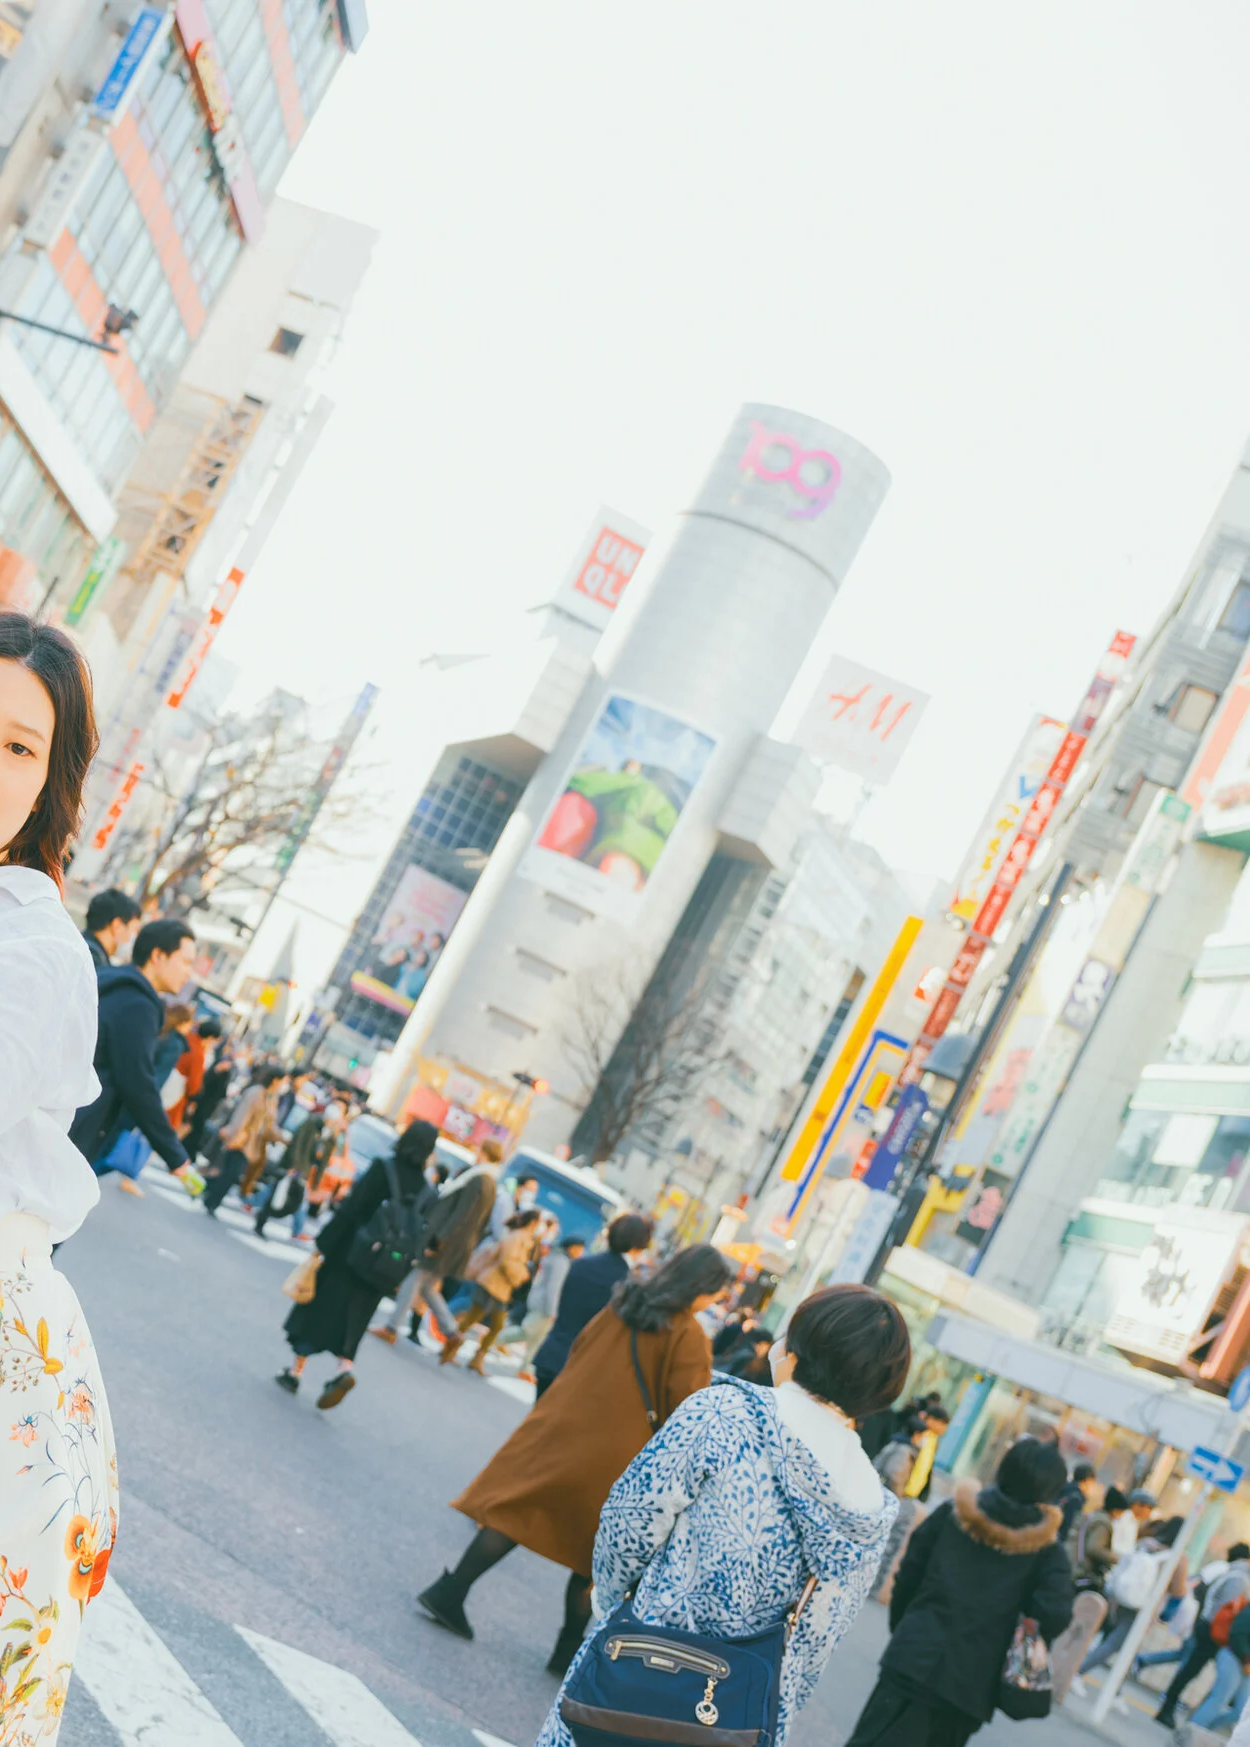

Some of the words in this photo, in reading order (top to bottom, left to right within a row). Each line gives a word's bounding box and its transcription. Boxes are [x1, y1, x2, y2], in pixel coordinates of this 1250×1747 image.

[738, 419, 843, 519] 109
[596, 535, 641, 577] UN
[583, 564, 618, 602] QL
